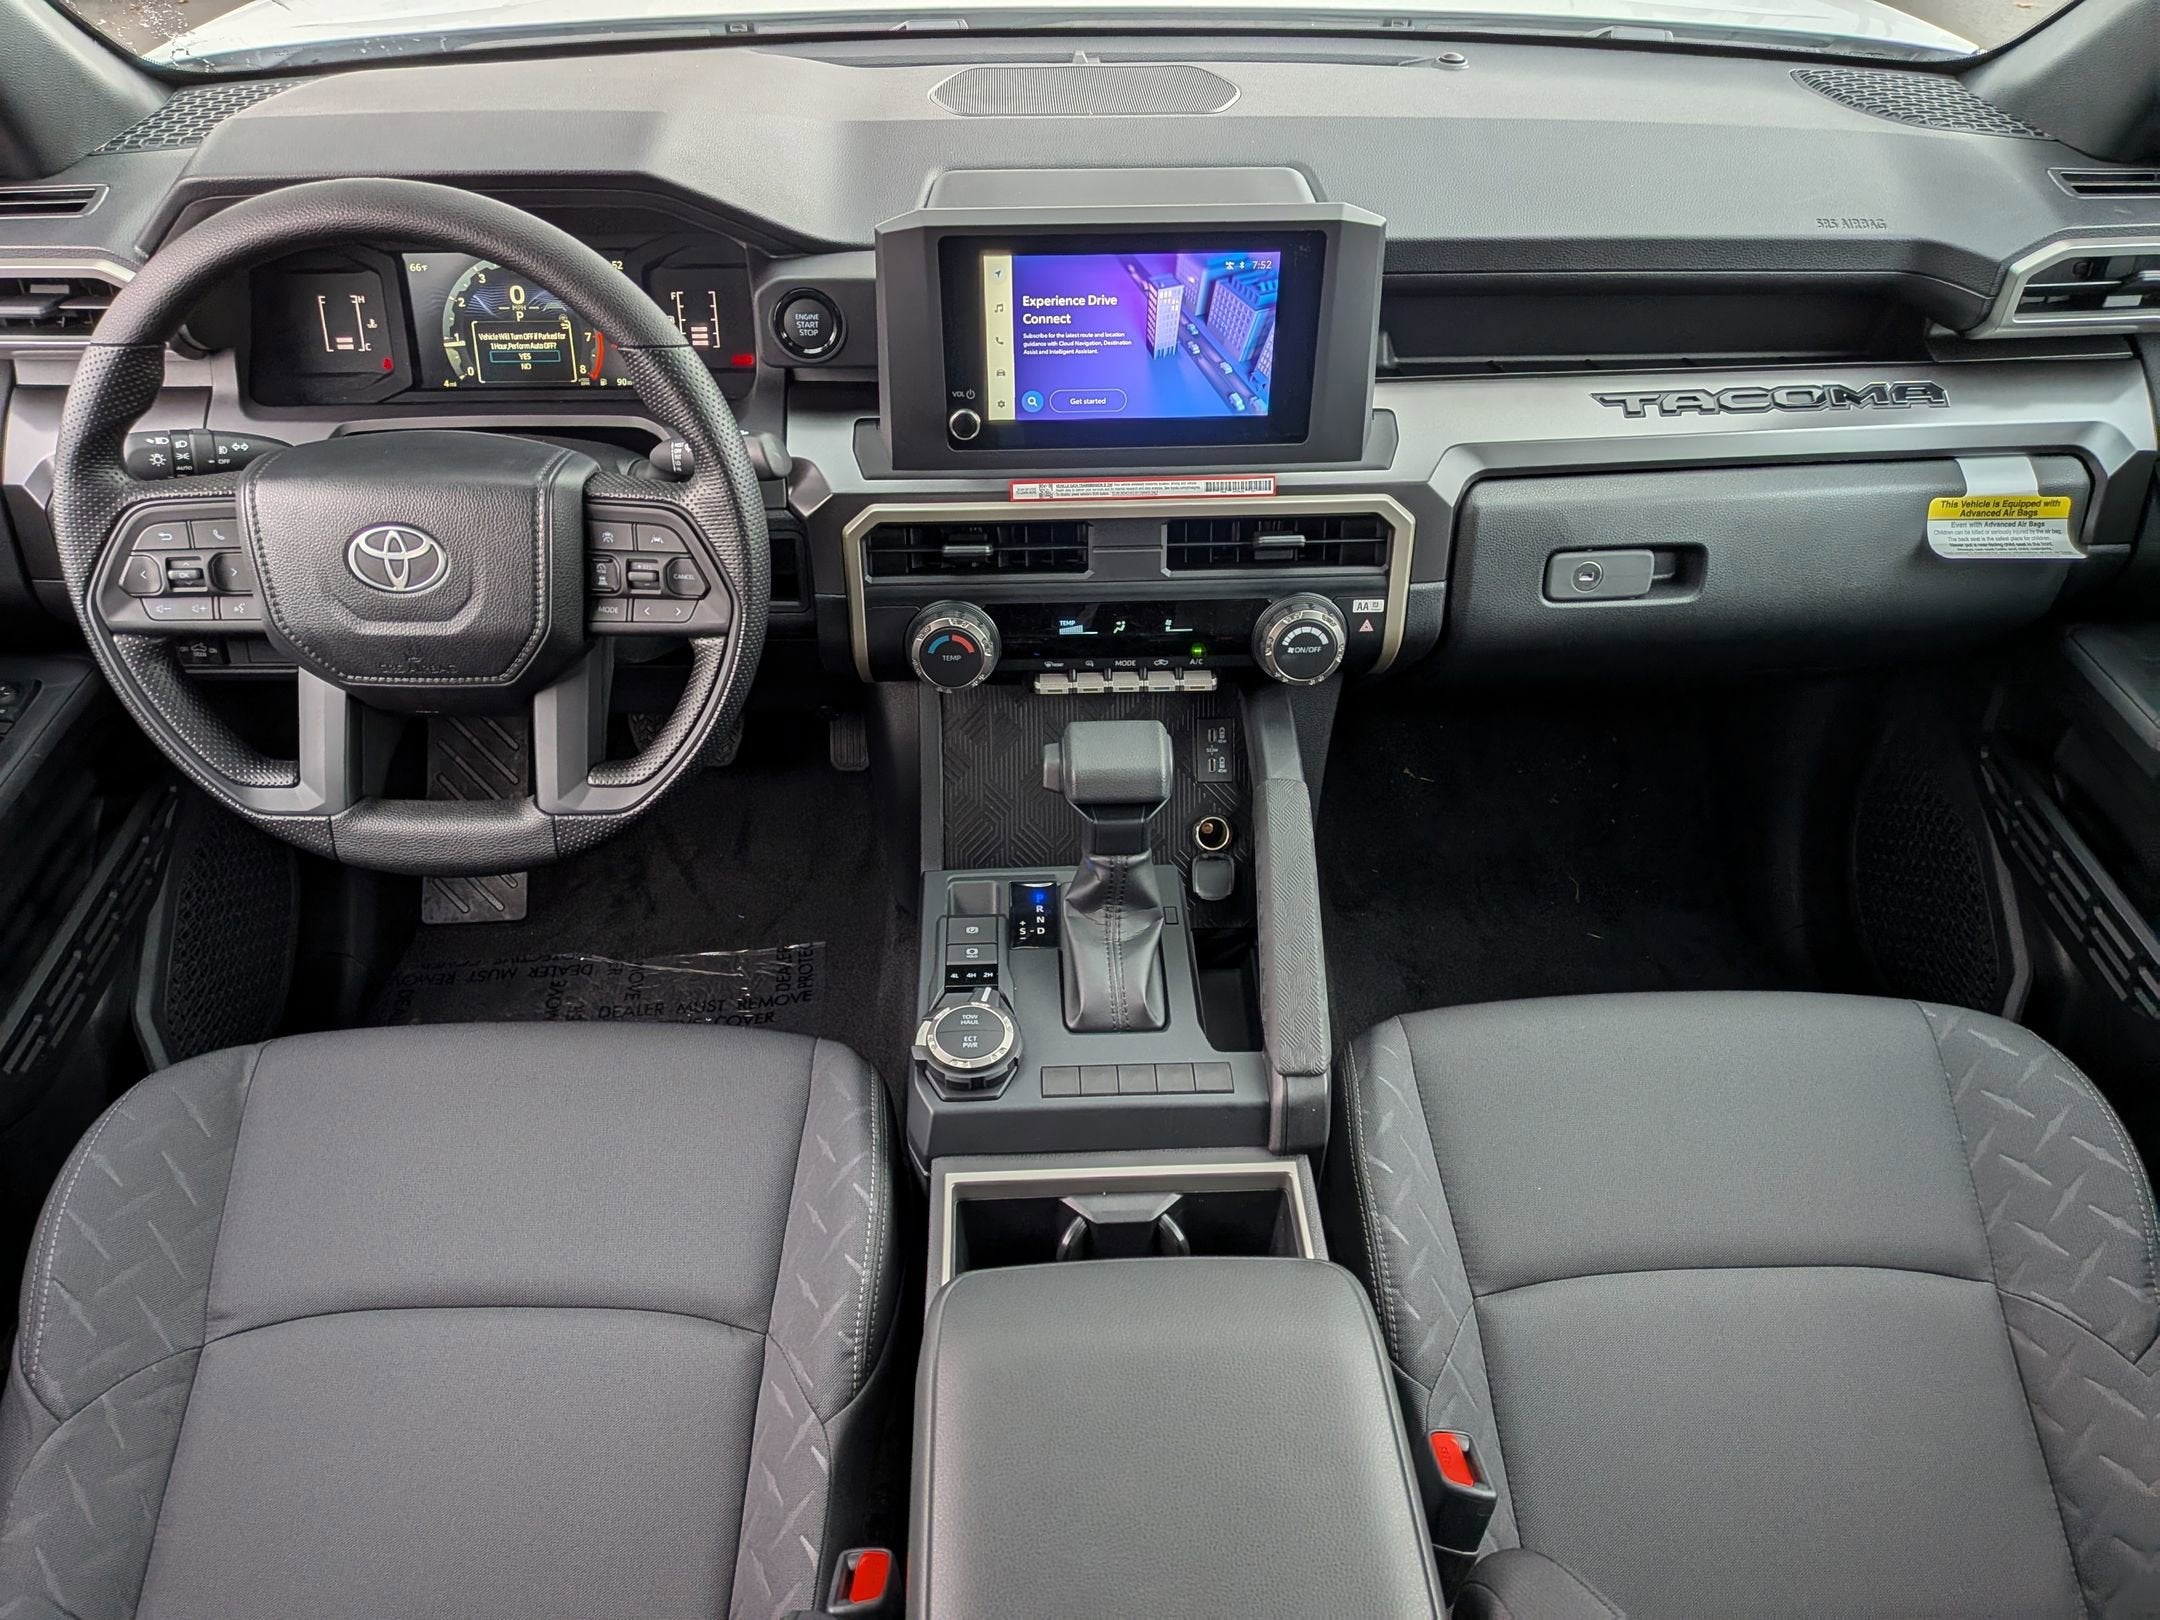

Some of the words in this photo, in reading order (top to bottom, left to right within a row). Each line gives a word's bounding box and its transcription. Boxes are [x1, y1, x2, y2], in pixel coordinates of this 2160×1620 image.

[1815, 217, 1839, 229] SRS
[1841, 217, 1887, 230] AIRBAG
[1252, 260, 1272, 270] 7:52
[478, 273, 487, 283] 3
[357, 295, 366, 304] H
[509, 285, 526, 305] 0
[457, 297, 466, 308] 2
[1022, 295, 1086, 308] Experience
[1087, 294, 1118, 306] Drive
[516, 312, 525, 322] P
[794, 313, 820, 321] ENGINE
[1022, 313, 1072, 325] Connect
[796, 320, 820, 329] START
[453, 332, 460, 342] 1
[478, 332, 499, 340] Vehicle
[499, 332, 511, 340] Will
[511, 332, 524, 340] Turn
[524, 332, 533, 340] OFF
[538, 332, 558, 340] Parked
[558, 332, 566, 340] for
[584, 332, 592, 342] 7
[799, 328, 819, 337] STOP
[365, 343, 372, 351] C
[530, 342, 544, 350] Auto
[544, 342, 557, 350] OFF?
[1074, 340, 1103, 348] Navigation,
[467, 366, 475, 376] 0
[579, 365, 587, 375] 8
[1070, 397, 1082, 405] Get
[1083, 397, 1107, 405] started
[1589, 380, 1951, 419] TACOMA
[1941, 500, 1959, 508] This
[1961, 500, 1991, 508] Vehicle
[1992, 500, 2000, 508] is
[2002, 499, 2041, 510] Equipped
[2043, 499, 2061, 507] with
[1959, 509, 2001, 518] Advanced
[2003, 509, 2016, 517] Air
[2017, 509, 2039, 519] Bags
[1984, 520, 2016, 528] Advanced
[2017, 520, 2027, 528] Air
[2028, 520, 2045, 529] Bags
[673, 573, 695, 581] CANCEL
[597, 606, 619, 614] MODE
[1294, 646, 1322, 654] ON/OFF
[942, 654, 962, 662] TEMP
[1115, 659, 1137, 667] MODE
[1035, 894, 1045, 903] P
[1036, 905, 1044, 913] R
[1019, 927, 1027, 935] S
[1036, 927, 1045, 935] D
[463, 967, 519, 982] MUST
[528, 963, 594, 978] DEALER
[598, 1002, 664, 1019] DEALER
[676, 998, 726, 1014] MUST
[736, 990, 813, 1010] REMOVE
